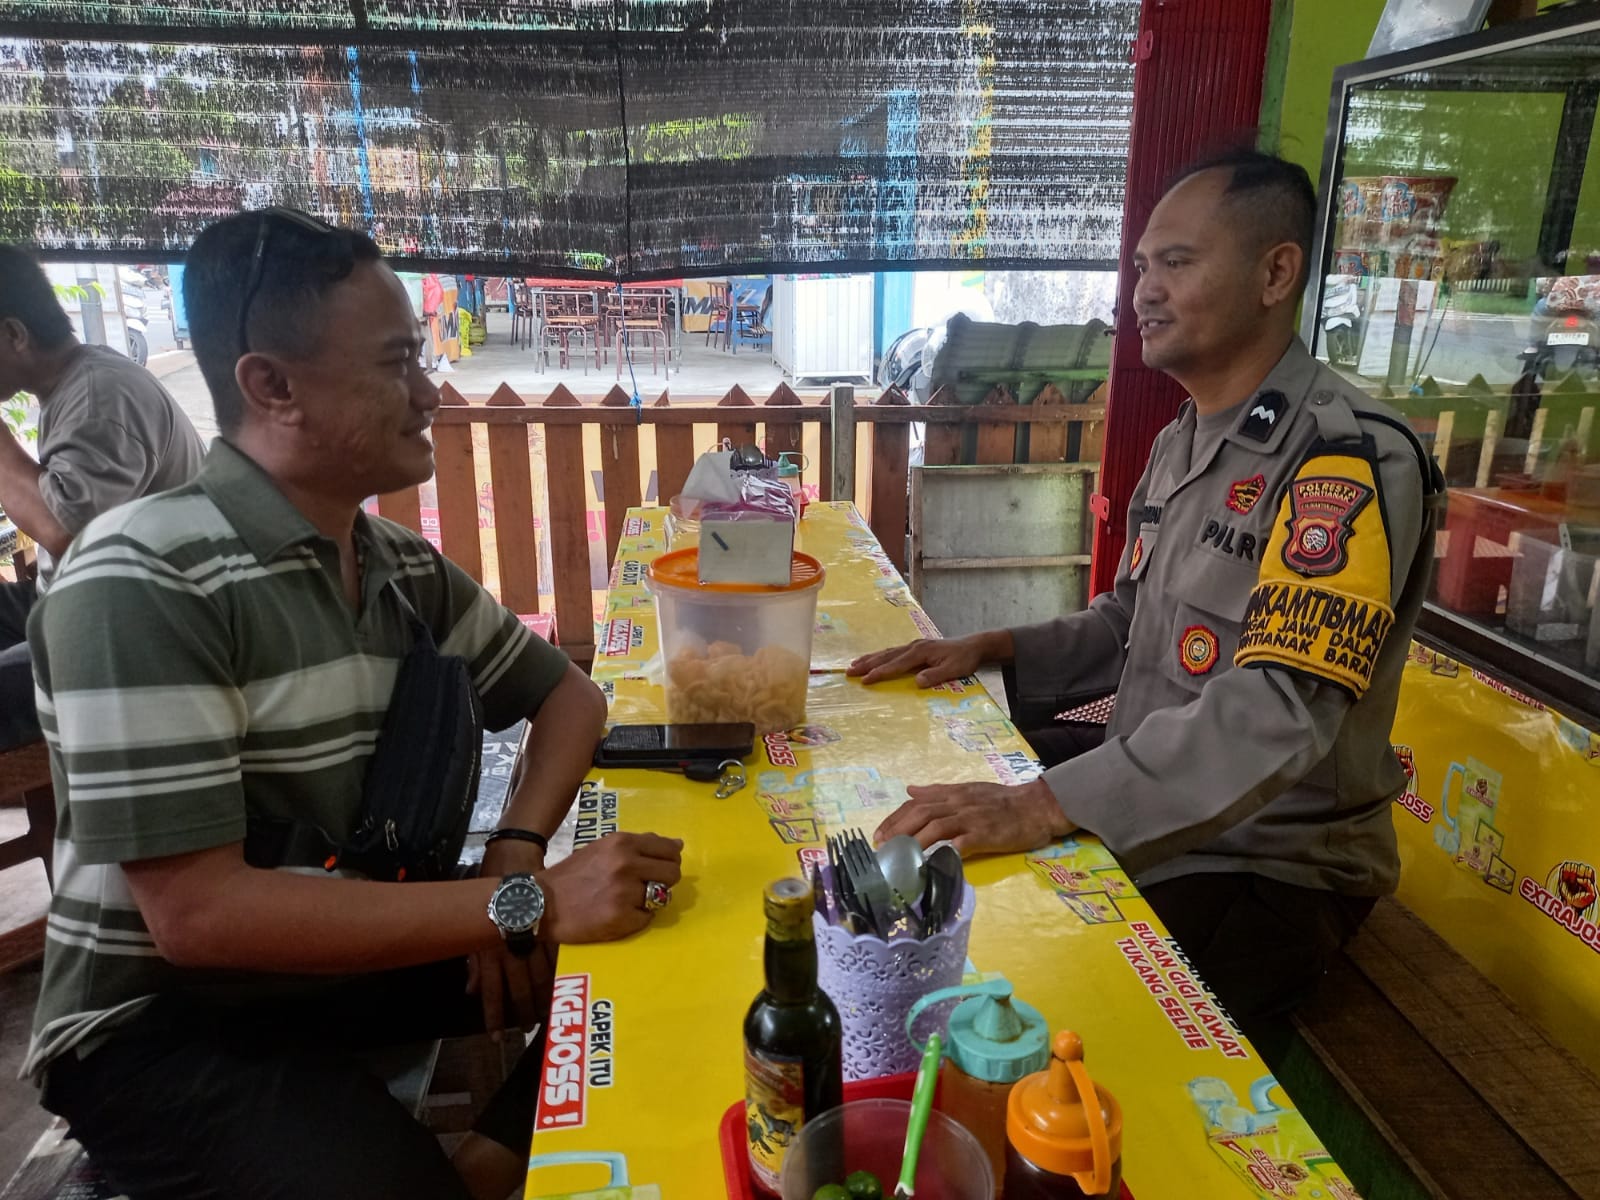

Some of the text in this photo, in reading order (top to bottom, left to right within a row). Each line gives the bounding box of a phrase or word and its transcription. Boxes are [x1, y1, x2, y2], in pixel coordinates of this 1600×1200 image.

[1277, 617, 1321, 641] JAWI
[1323, 646, 1371, 682] BARA
[1117, 937, 1170, 995] TUKANG
[1158, 996, 1212, 1049] SELFIE
[1130, 921, 1179, 969] BUKAN
[1167, 970, 1203, 999] GIGI
[1188, 1001, 1248, 1058] KAWAT
[544, 976, 585, 1107] NGEJOSS
[589, 1000, 612, 1087] CAPEK ITU
